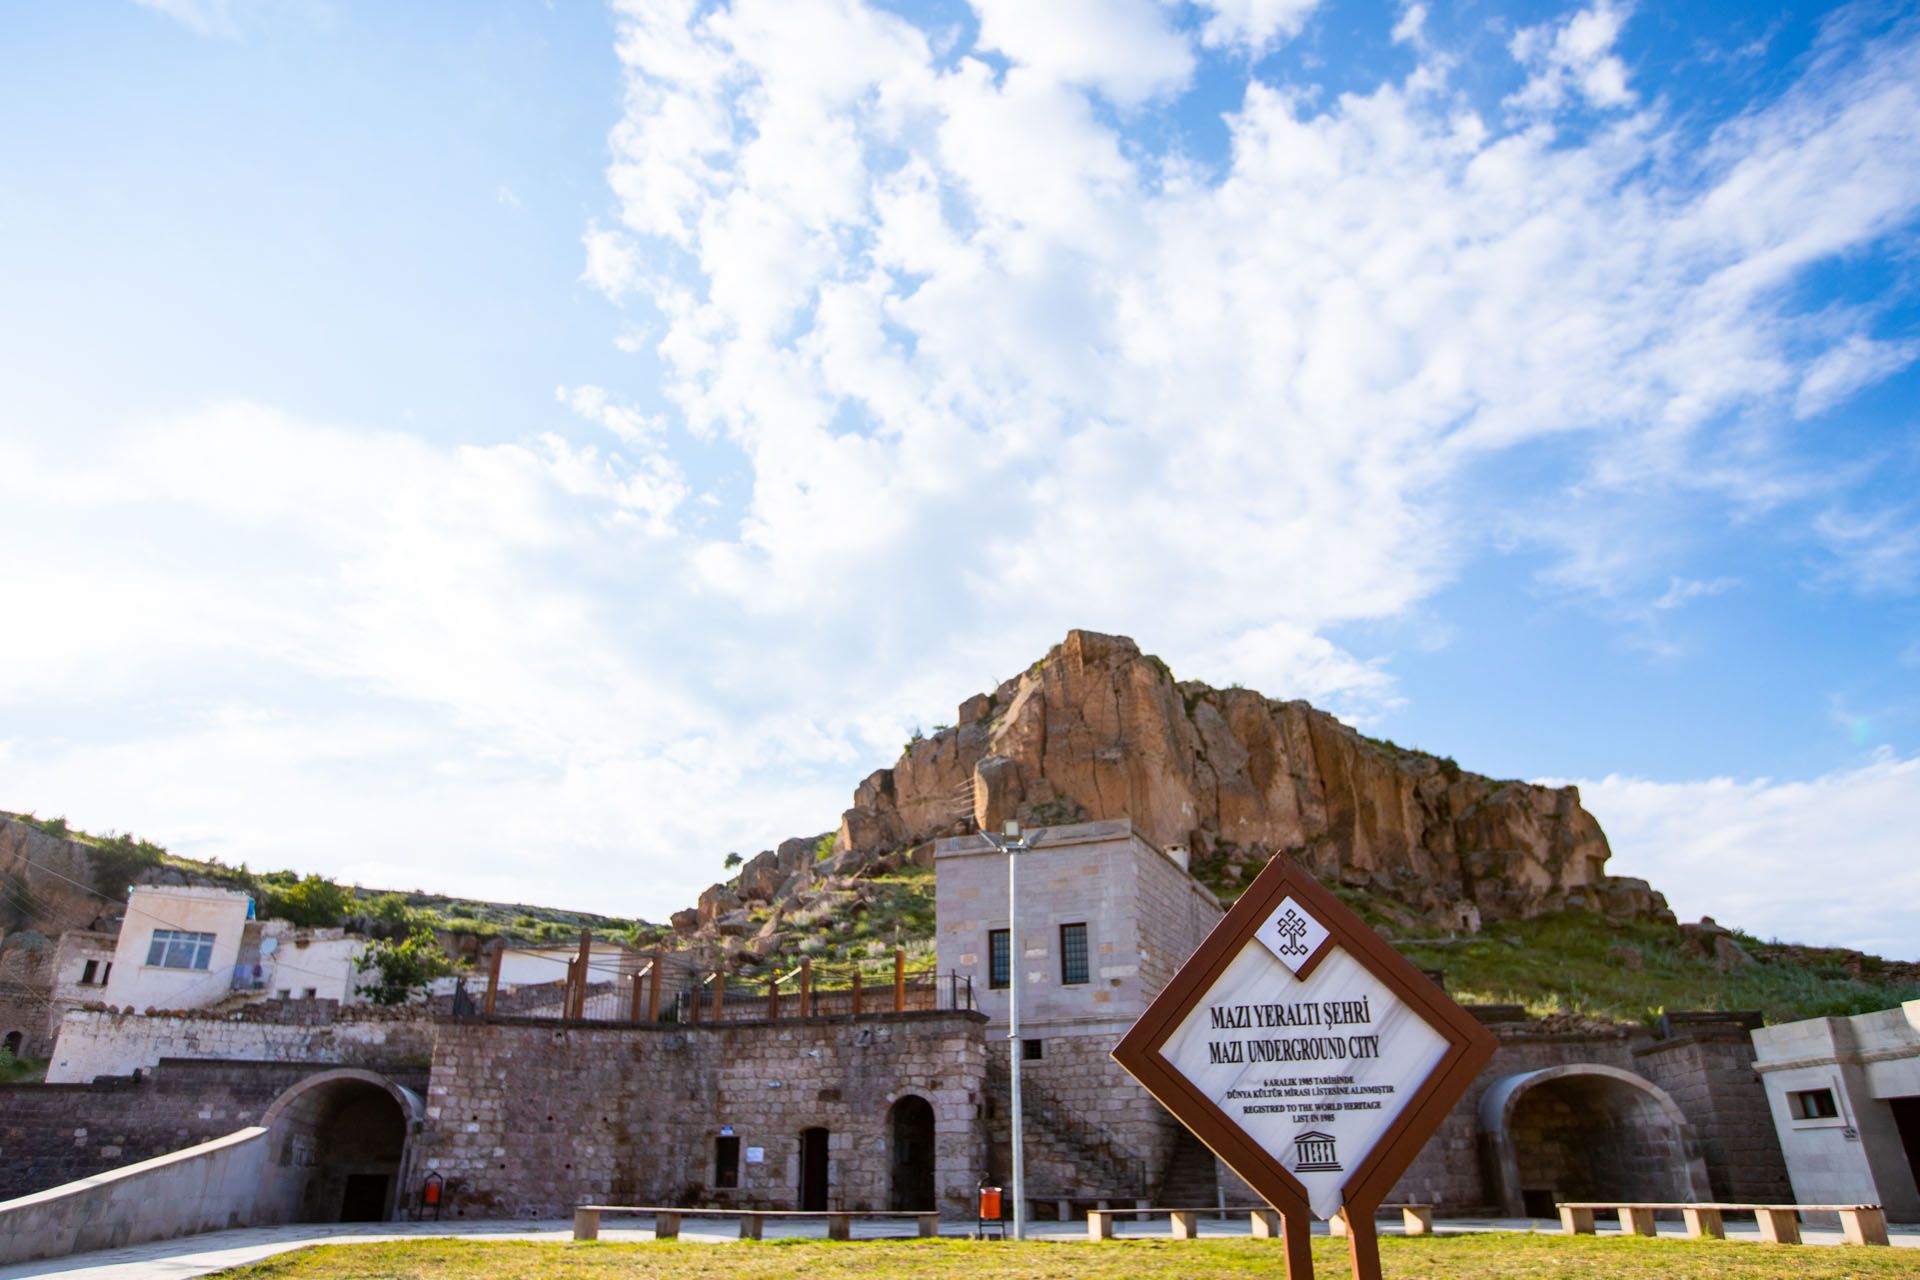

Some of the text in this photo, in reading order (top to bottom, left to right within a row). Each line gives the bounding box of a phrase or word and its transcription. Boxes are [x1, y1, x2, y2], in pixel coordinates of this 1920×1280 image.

[1211, 995, 1371, 1030] MAZI YERALTI ŞEHRİ
[1208, 1035, 1380, 1064] MAZI UNDERGROUND CITY
[1269, 1078, 1297, 1087] ARALIK
[1314, 1075, 1354, 1085] TARİHİNDE
[1226, 1085, 1395, 1099] DÜNYA KÜLTÜR MİRASI LİSTESİNE ALINMIŞTIR
[1243, 1101, 1382, 1114] REGISTRED TO THE WORLD HERITAGE
[1292, 1115, 1310, 1123] LIST
[1310, 1114, 1319, 1122] IN
